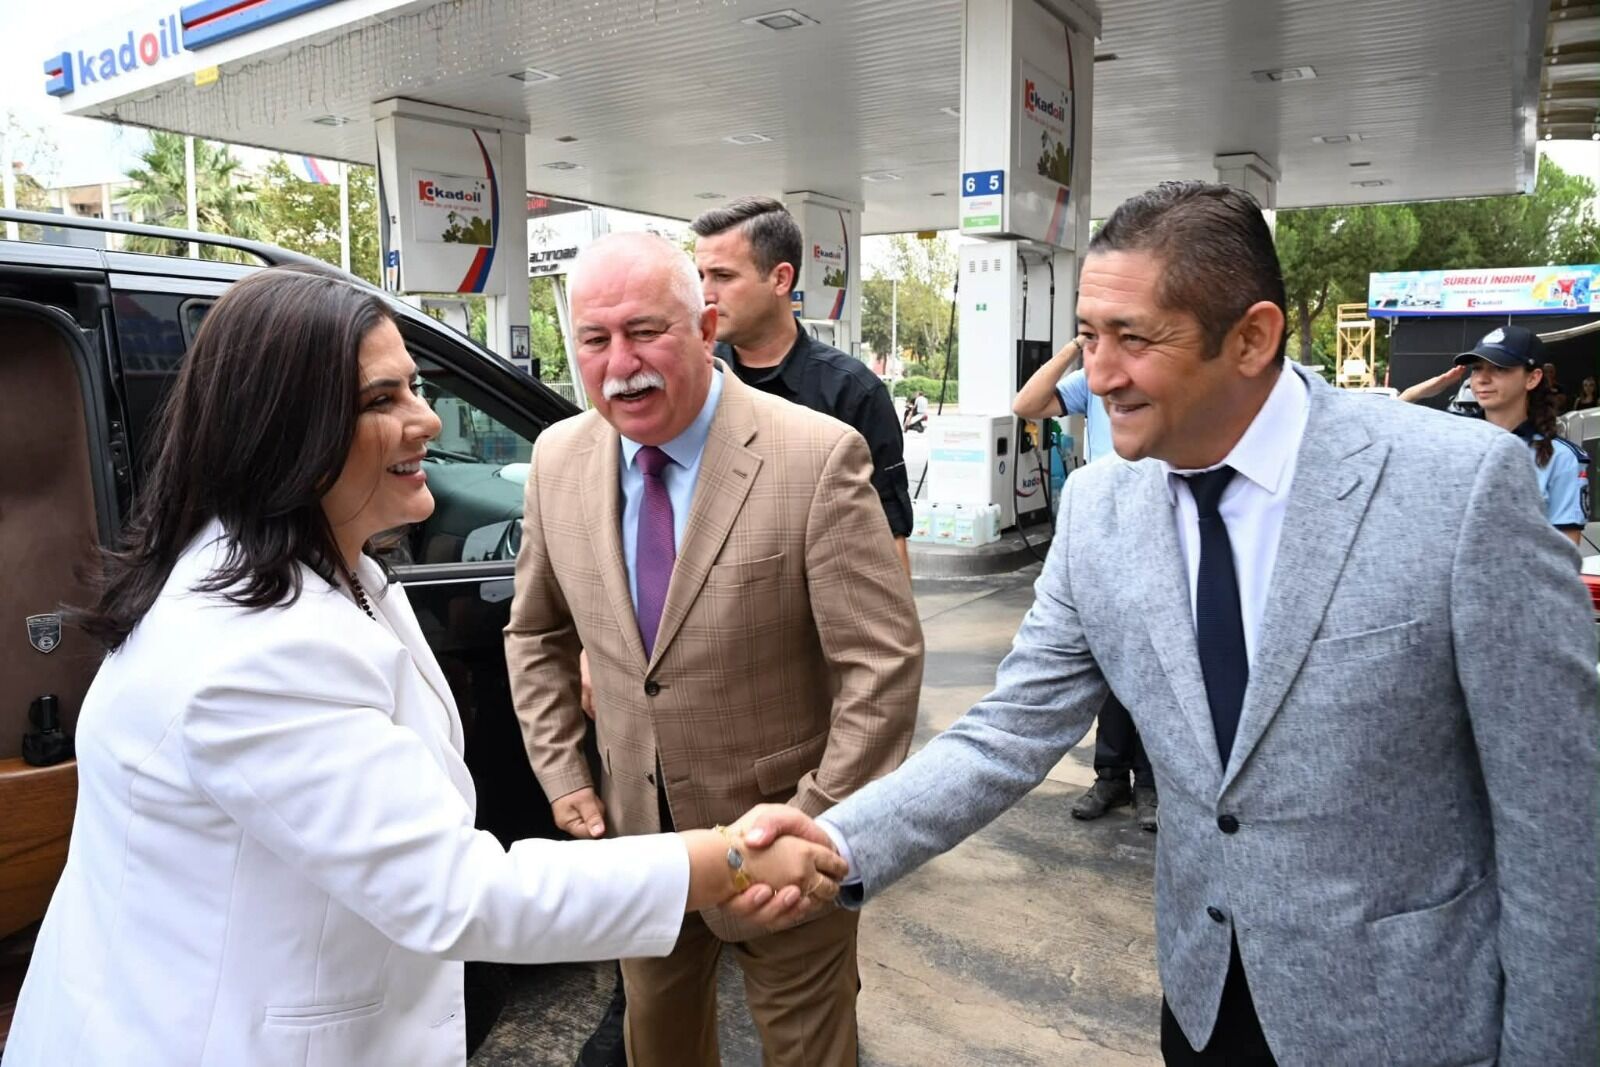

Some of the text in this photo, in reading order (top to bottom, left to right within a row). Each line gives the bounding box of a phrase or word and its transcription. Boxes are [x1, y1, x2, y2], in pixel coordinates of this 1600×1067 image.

[78, 14, 180, 86] kadoil
[1035, 92, 1065, 123] kadoil
[435, 186, 481, 203] kadoil
[966, 175, 999, 193] 6 5
